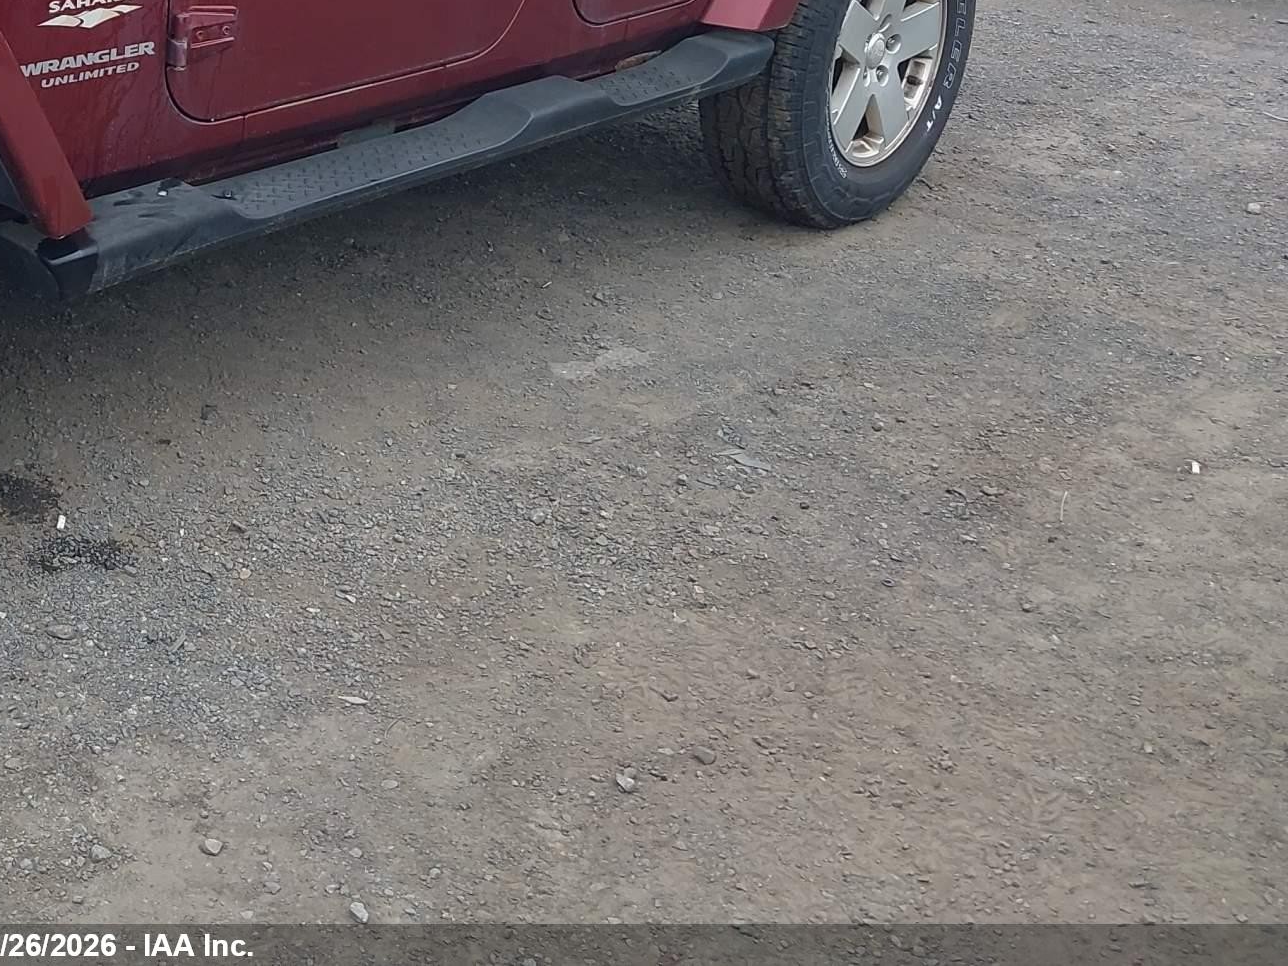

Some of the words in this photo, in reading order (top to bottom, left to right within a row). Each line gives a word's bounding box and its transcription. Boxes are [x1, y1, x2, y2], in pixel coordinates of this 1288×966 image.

[21, 41, 156, 78] WRANGLER
[41, 62, 140, 88] UNLIMITED
[925, 95, 945, 140] A/T
